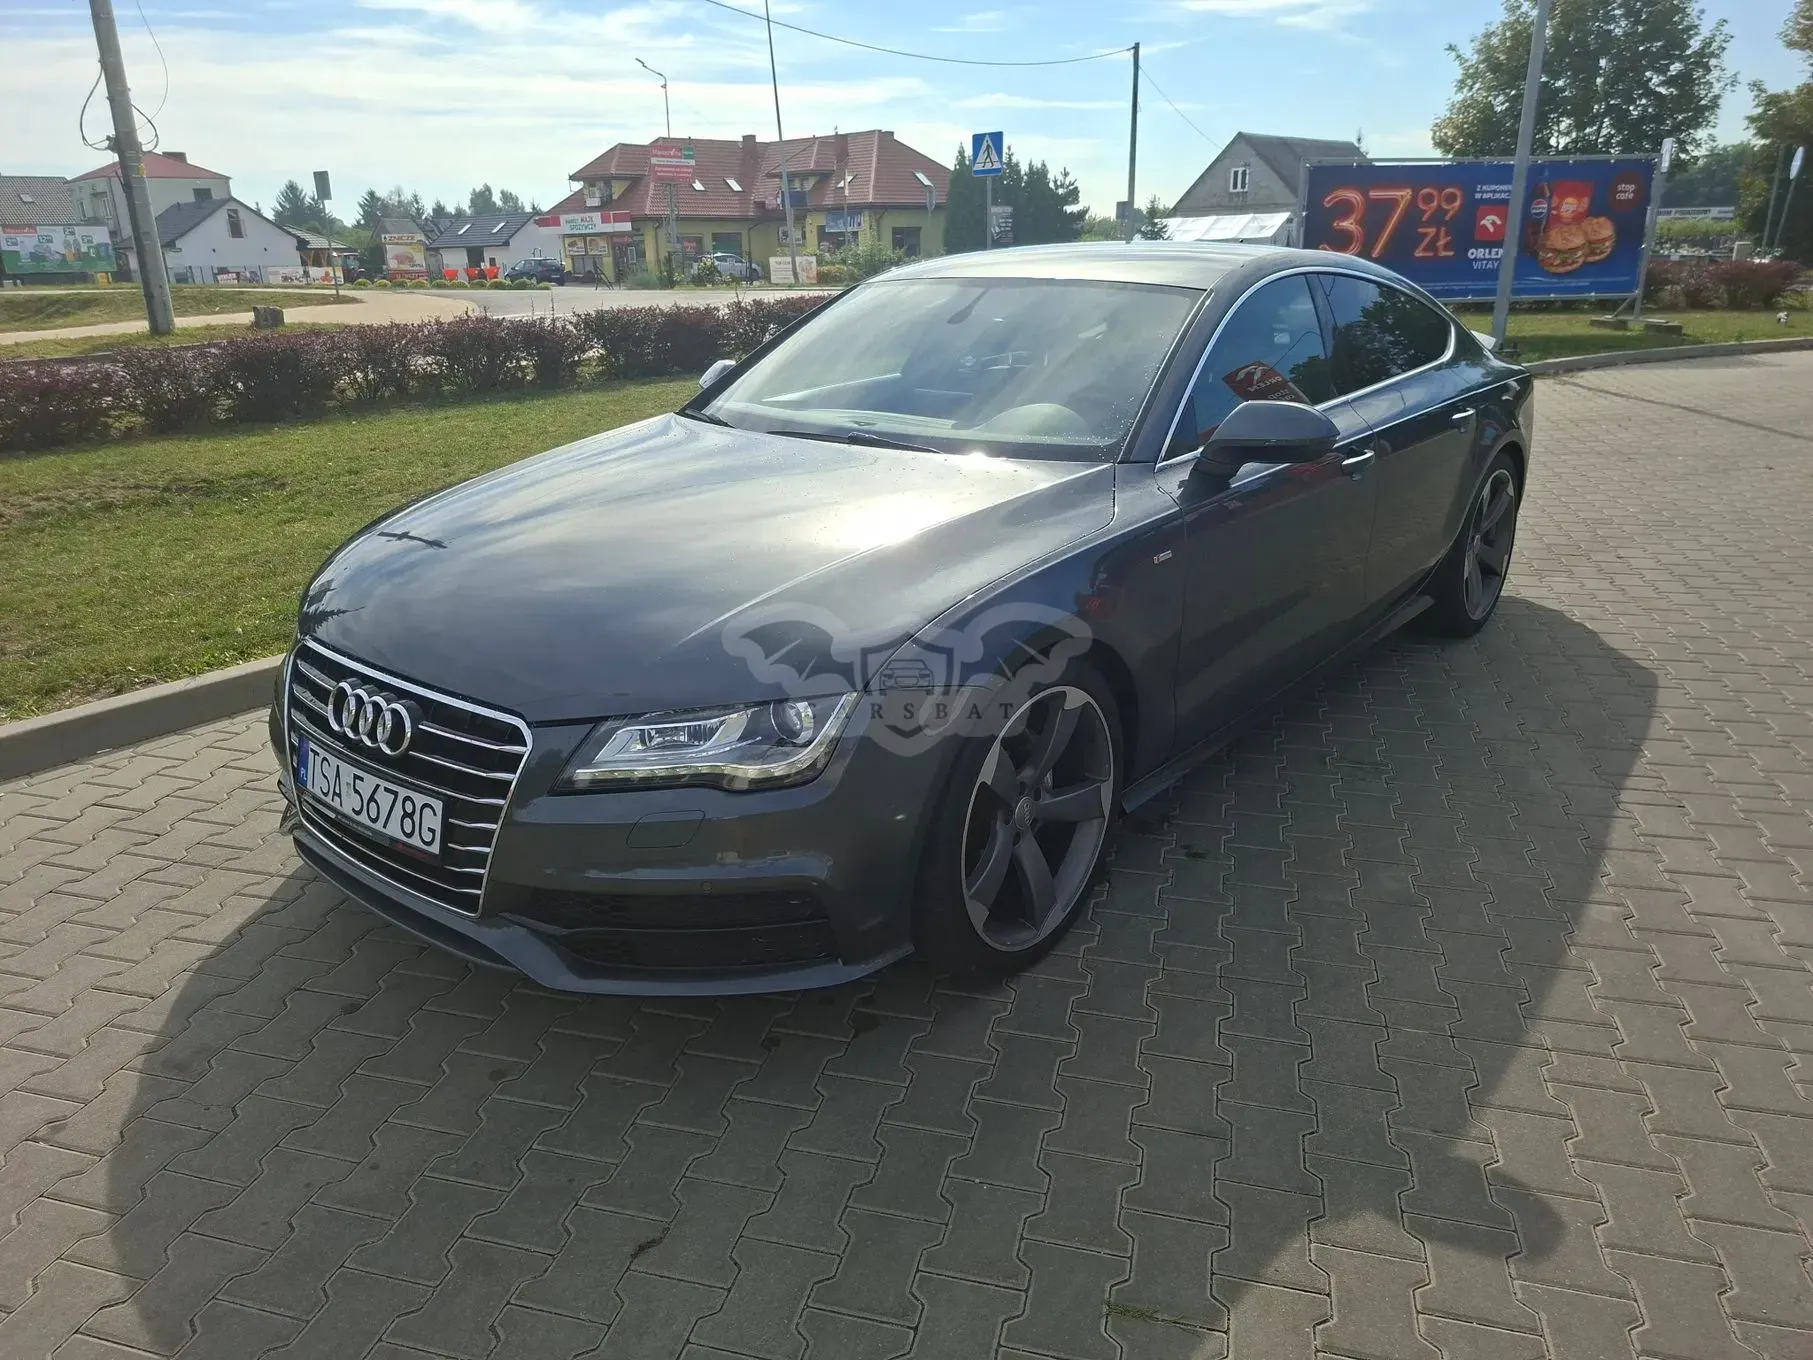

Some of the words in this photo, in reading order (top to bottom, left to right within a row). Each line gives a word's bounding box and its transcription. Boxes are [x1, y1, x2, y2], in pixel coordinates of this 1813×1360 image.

[1476, 184, 1481, 192] Z
[1617, 183, 1636, 192] stop
[1616, 192, 1635, 200] cafe
[1318, 187, 1413, 258] 37
[1416, 187, 1464, 222] 99
[1414, 227, 1454, 257] ZŁ
[1472, 261, 1500, 270] VITAY
[299, 767, 308, 781] PL
[309, 747, 344, 809] TSA
[351, 772, 438, 848] 5678G
